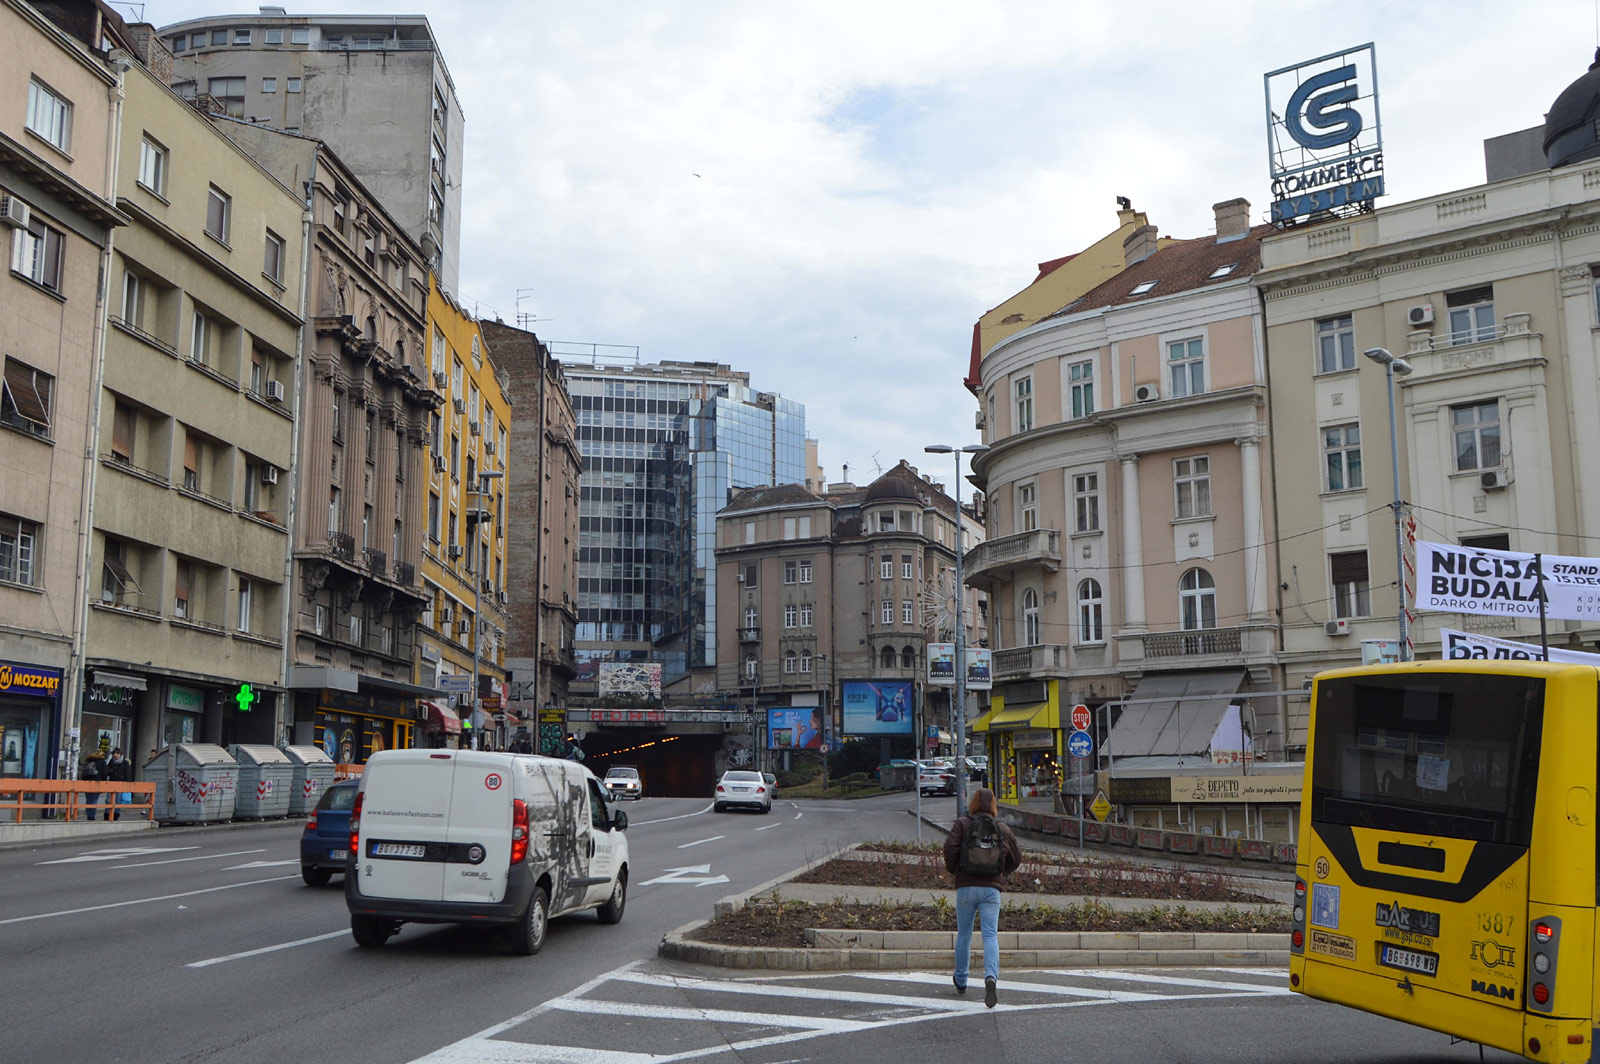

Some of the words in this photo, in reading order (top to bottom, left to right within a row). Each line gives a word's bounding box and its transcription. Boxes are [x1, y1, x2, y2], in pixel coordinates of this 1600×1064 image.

[1271, 153, 1384, 196] COMMERCE
[1272, 178, 1382, 220] SYSTEM
[1431, 550, 1550, 581] NIČIJA
[1552, 564, 1598, 576] STAND
[1431, 575, 1550, 603] BUDALA
[1430, 597, 1478, 610] DARKO
[13, 672, 60, 690] MOZZART
[90, 682, 134, 707] SHOESTAR
[1073, 713, 1089, 723] STOP
[930, 727, 936, 735] P
[488, 777, 498, 786] 80
[1242, 785, 1255, 795] jela
[367, 810, 444, 818] www.balasevicfashion.com
[378, 844, 389, 854] BG
[1316, 862, 1328, 875] 50
[1478, 911, 1516, 937] 1387
[1384, 927, 1432, 948] www.gsp.co.rs
[1312, 944, 1328, 953] ДУГО
[1387, 946, 1400, 962] BG
[1471, 979, 1516, 1001] MAN
